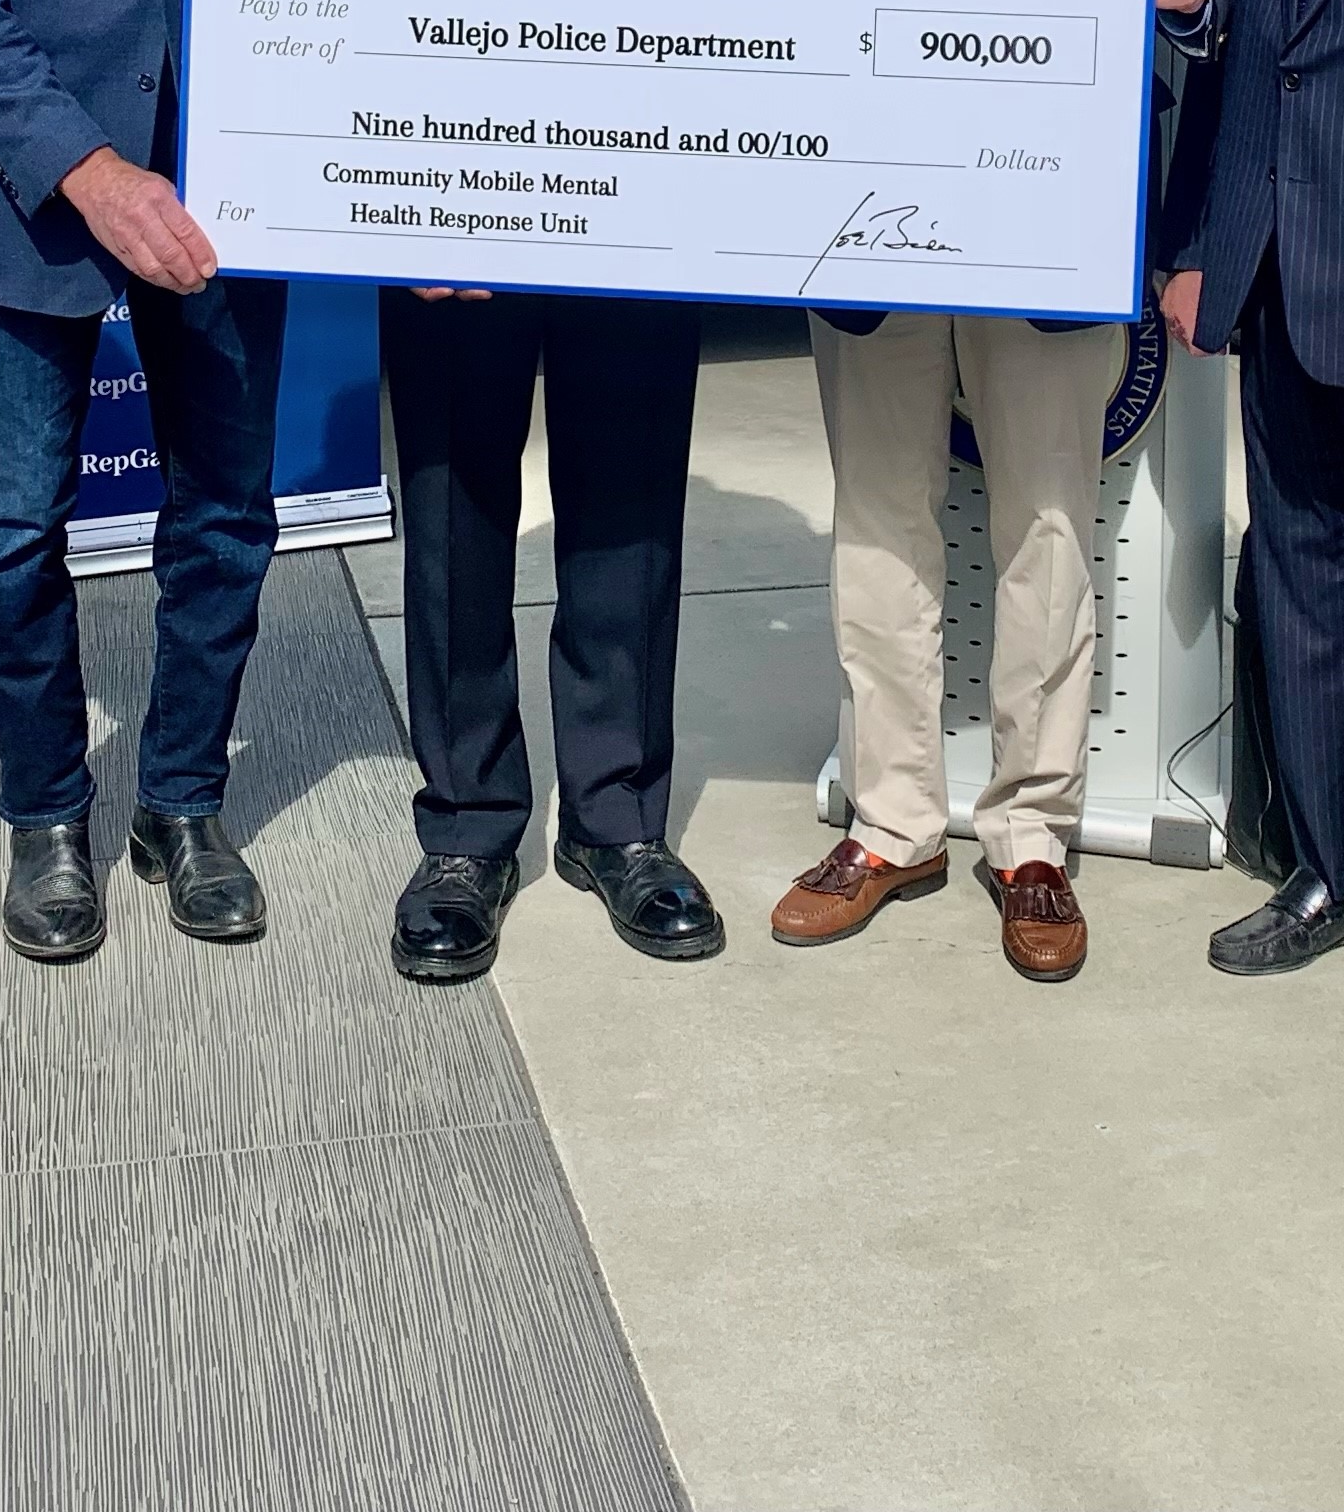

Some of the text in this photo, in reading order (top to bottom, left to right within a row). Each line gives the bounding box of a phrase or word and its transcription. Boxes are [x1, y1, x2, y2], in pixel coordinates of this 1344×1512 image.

[288, 0, 309, 18] to
[252, 36, 313, 59] order
[319, 37, 345, 64] of
[408, 17, 509, 55] Vallejo
[518, 22, 607, 53] Police
[615, 26, 796, 63] Department
[919, 31, 1052, 68] 900,000
[351, 111, 1062, 173] Nine hundred thousand and 00/100 Dollars
[322, 162, 619, 197] Community Mobile Mental
[216, 200, 589, 235] For Health Response Unit
